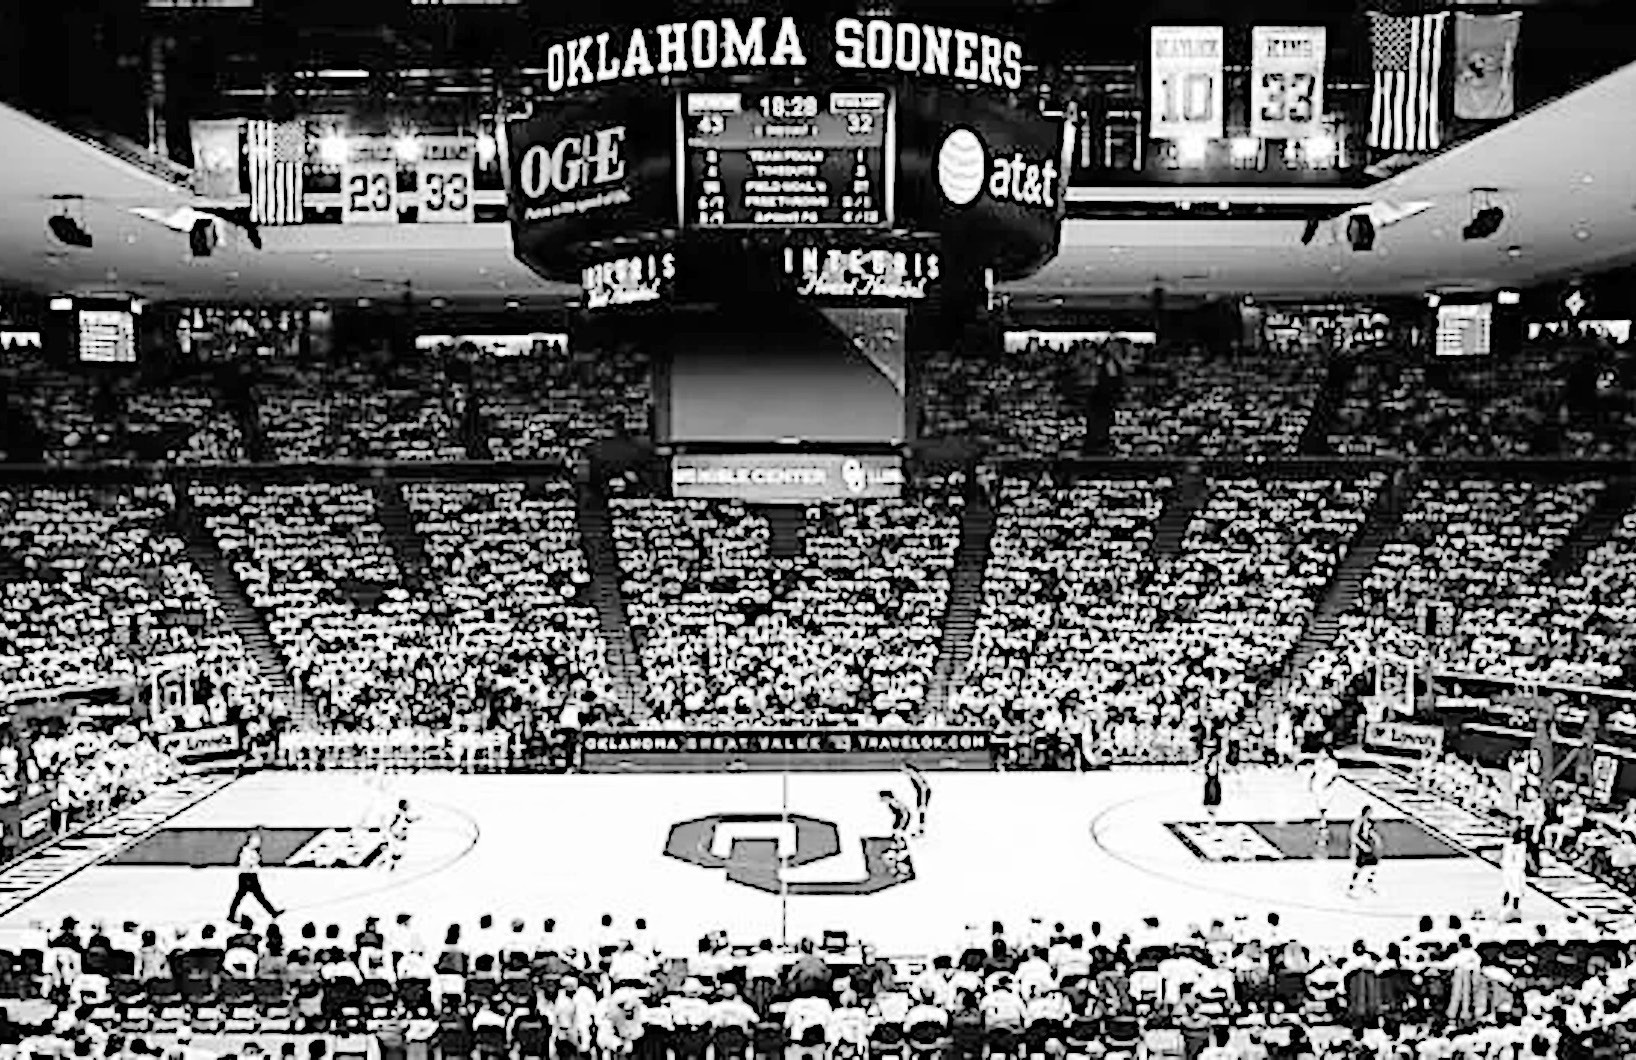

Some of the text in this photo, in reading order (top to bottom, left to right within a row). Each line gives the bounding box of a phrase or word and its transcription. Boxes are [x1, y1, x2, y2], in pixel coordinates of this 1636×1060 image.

[548, 16, 1022, 92] OKLAHOMA SOONERS
[1161, 72, 1213, 122] 10
[1261, 73, 1316, 122] 33
[847, 113, 873, 133] 32
[350, 175, 391, 212] 23
[426, 173, 468, 211] 33
[989, 152, 1057, 207] at&t
[584, 737, 679, 750] OKLAHOMA
